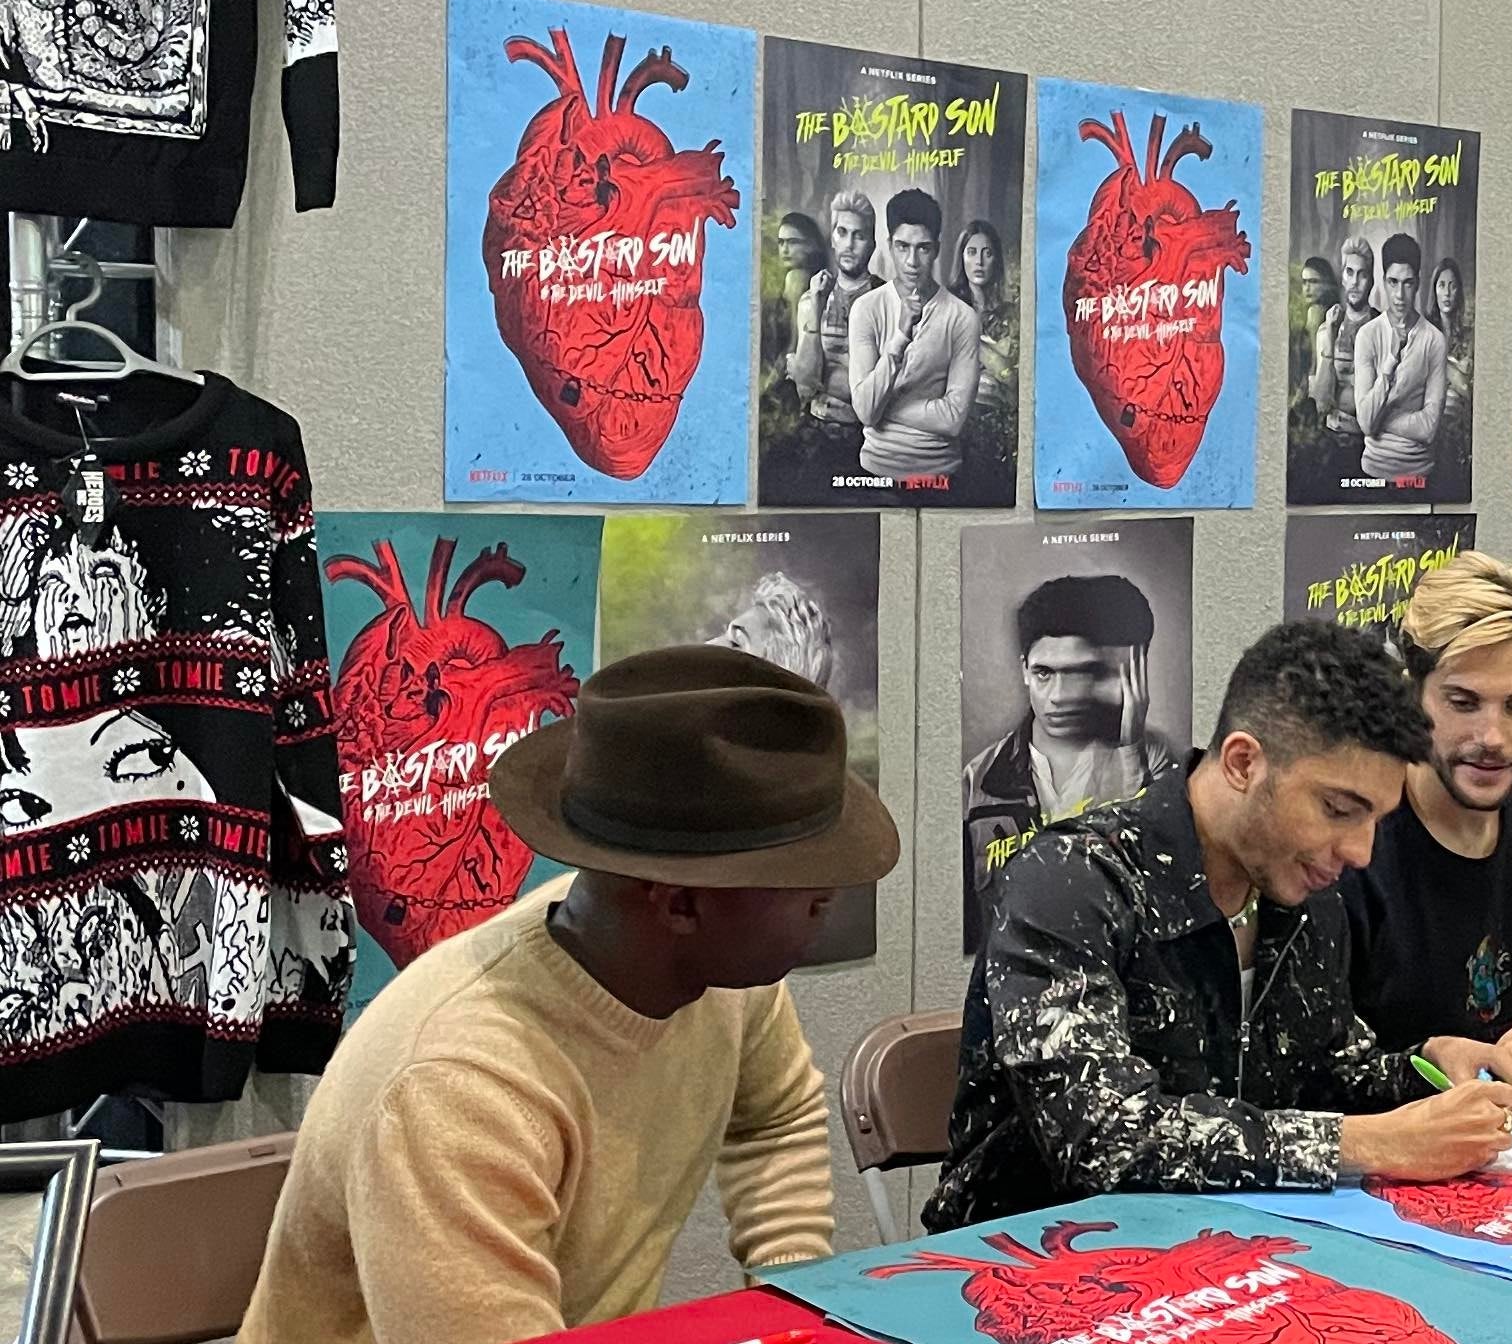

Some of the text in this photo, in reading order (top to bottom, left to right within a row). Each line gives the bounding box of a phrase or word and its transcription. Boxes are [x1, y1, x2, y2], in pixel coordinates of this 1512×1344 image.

[860, 66, 936, 85] A NETFLIX SERIES
[796, 81, 999, 148] THE BASTARD SON
[860, 150, 900, 176] DEVIL
[902, 148, 965, 184] HIMSELF
[1315, 139, 1462, 201] THE BASTARD SON
[1395, 197, 1438, 225] HIMSELF
[501, 216, 700, 282] THE BASTARD SON
[568, 282, 605, 306] DEVIL
[609, 278, 667, 311] HIMSELF
[1075, 265, 1221, 324] THE BASTARD SON
[469, 470, 576, 482] NETFLIX 28 OCTOBER
[832, 474, 949, 490] 28 OCTOBER NETFLIX
[1351, 478, 1385, 488] OCTOBER
[81, 471, 104, 523] HEROES
[701, 532, 790, 543] A NETFLIX SERIES
[1042, 533, 1119, 544] A NETFLIX SERIES
[1354, 531, 1415, 540] A NETFLIX SERIES
[1307, 580, 1333, 610] THE
[1335, 554, 1415, 609] BASTARD
[22, 660, 224, 714] TOMIE TOMIE
[362, 739, 477, 803] BASTARD
[393, 796, 434, 824] DEVIL
[986, 834, 1017, 873] THE
[1094, 1287, 1238, 1343] BASTARD
[1224, 1259, 1301, 1293] SON
